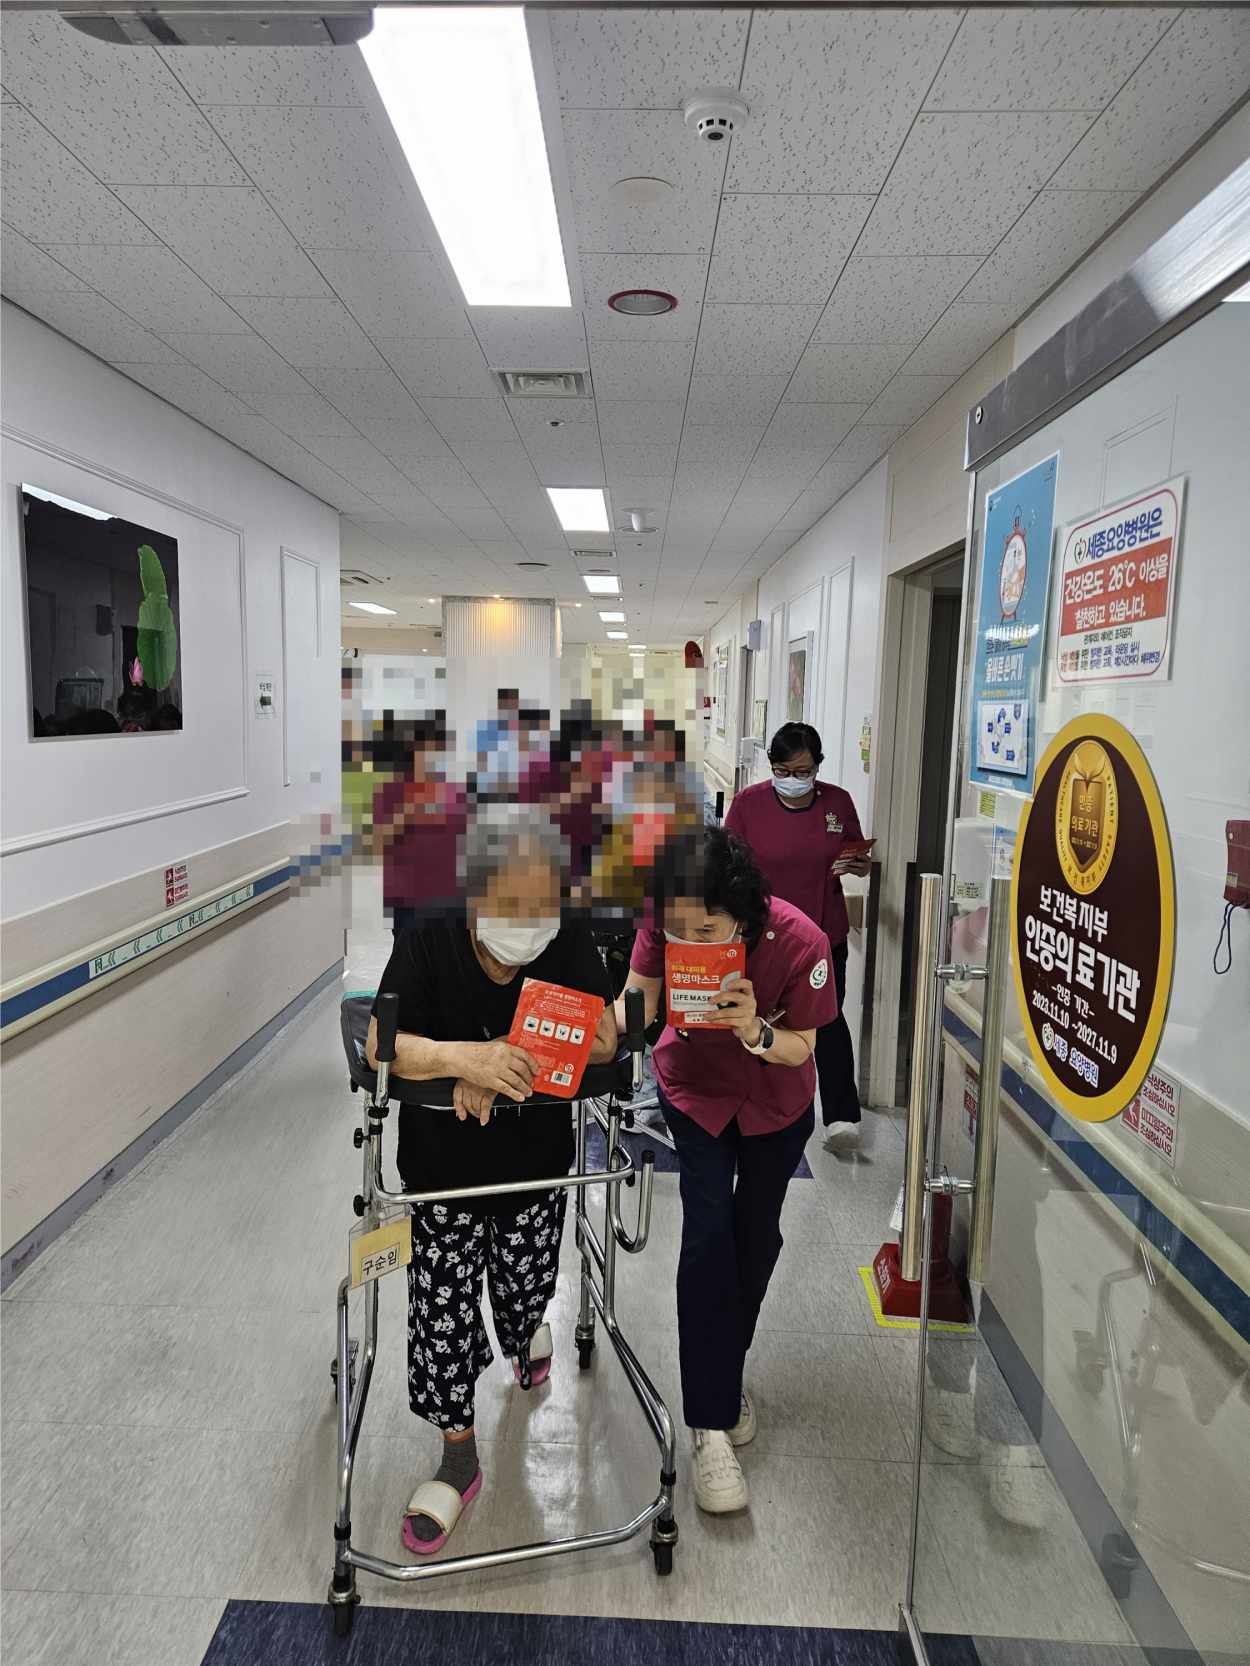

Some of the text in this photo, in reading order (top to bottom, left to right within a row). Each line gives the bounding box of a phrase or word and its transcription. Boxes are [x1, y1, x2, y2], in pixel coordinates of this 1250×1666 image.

[1086, 507, 1163, 560] 세종요양병원은
[1065, 568, 1104, 605] 건강온도
[1139, 553, 1169, 583] 이상을
[1109, 593, 1146, 624] 있습니다.
[1079, 794, 1093, 813] 인증
[1071, 815, 1099, 838] 의료기관
[1039, 884, 1109, 943] 보건복지부
[671, 972, 720, 985] 생명마스크
[672, 993, 689, 1001] LIFE
[1032, 989, 1070, 1030] 2023.11.10
[1054, 1033, 1099, 1088] 세종 요양병원
[1143, 1085, 1176, 1118] 조심하십시오
[1139, 1122, 1172, 1157] 조심하십시오
[1142, 1107, 1173, 1143] 미끄럼주의
[363, 1248, 397, 1276] 구순임
